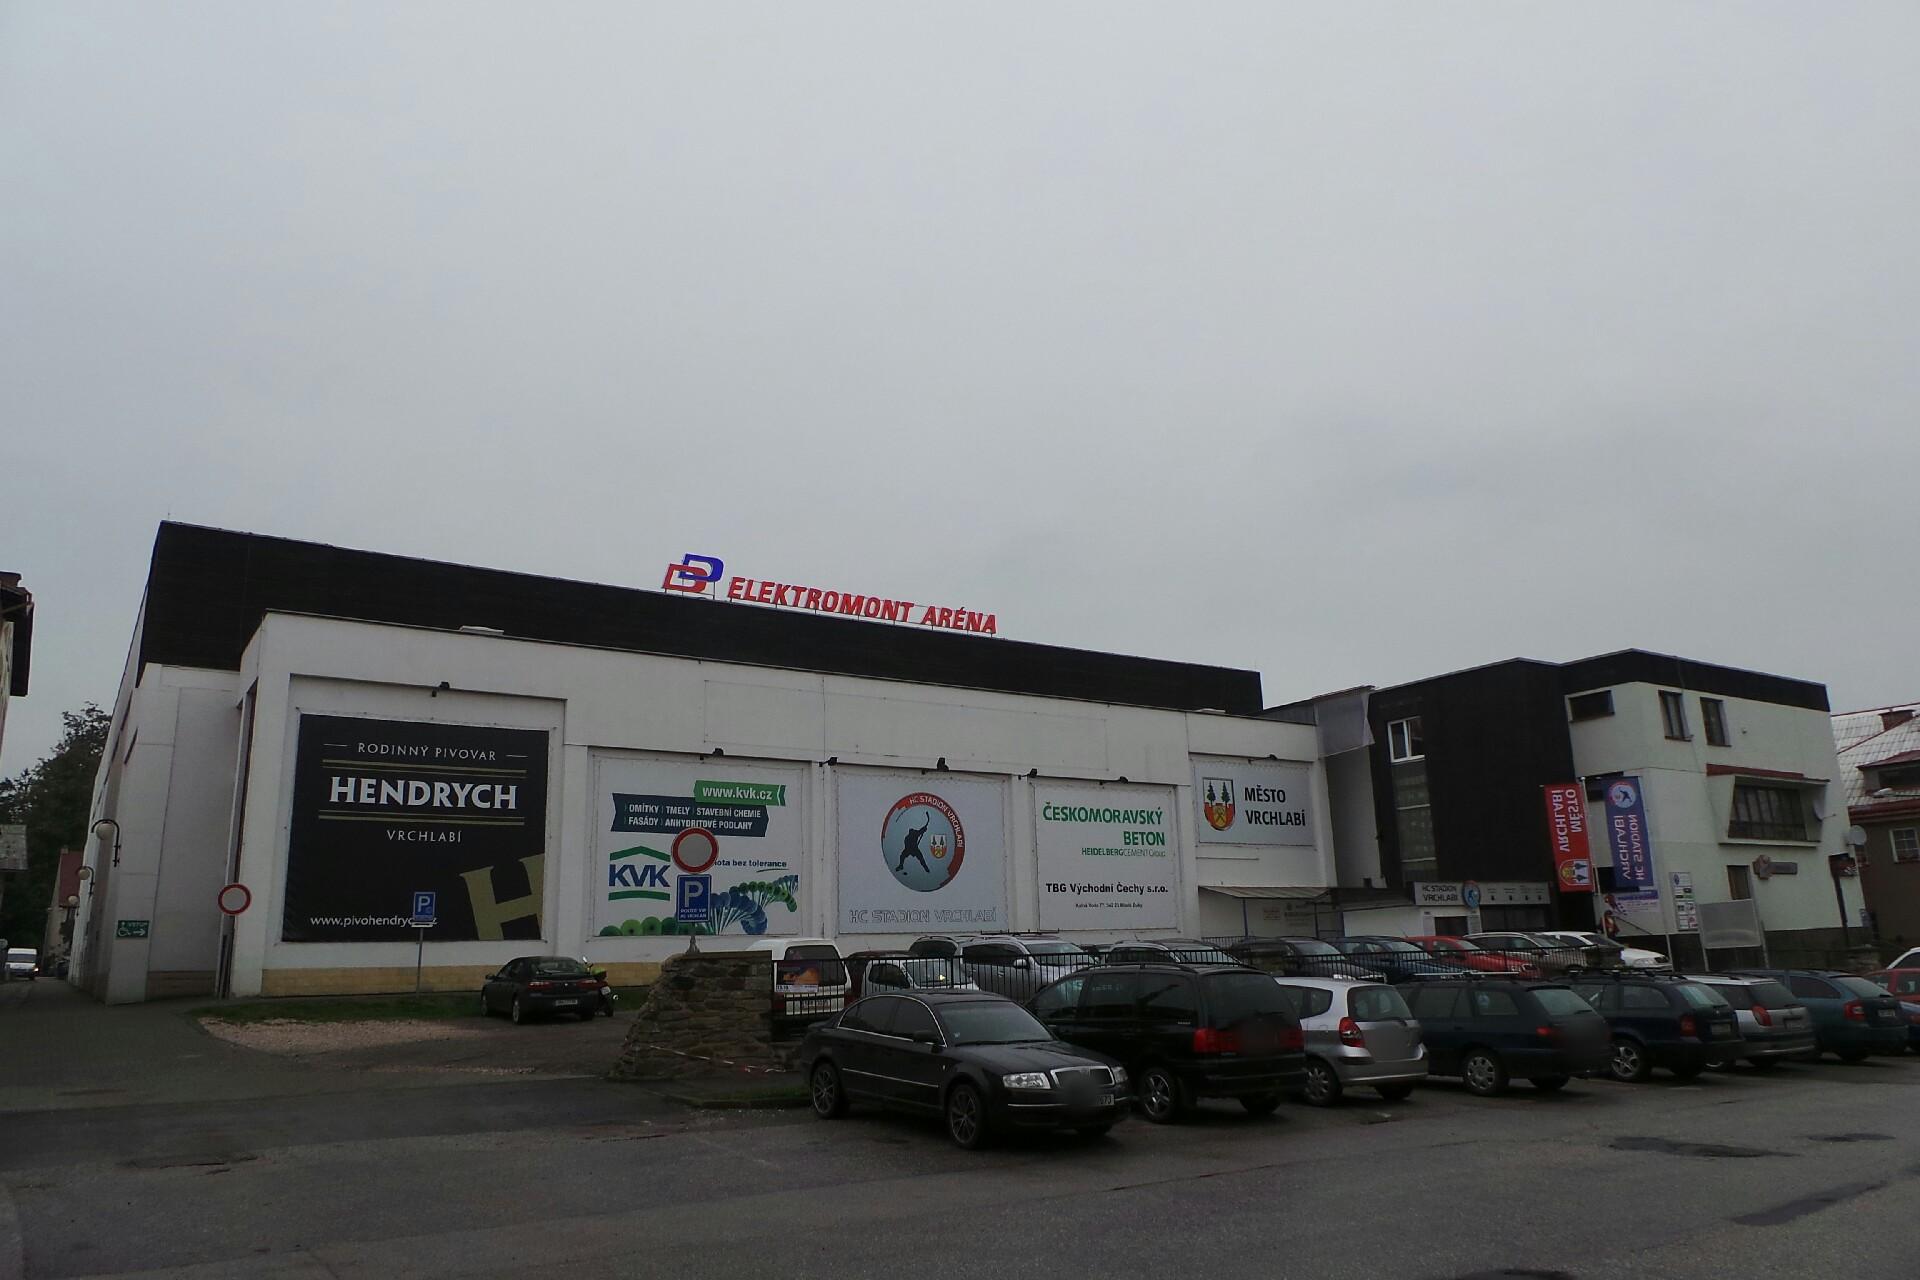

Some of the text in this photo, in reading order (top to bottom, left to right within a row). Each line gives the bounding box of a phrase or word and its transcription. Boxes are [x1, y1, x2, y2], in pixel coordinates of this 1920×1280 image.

[728, 576, 996, 634] ELEKTROMONT ARÉNA
[358, 742, 496, 761] RODINNÝ PIVOVAR
[329, 776, 518, 810] HENDRYCH
[702, 786, 773, 800] www.kvk.cz
[1244, 784, 1286, 803] MĚSTO
[629, 802, 761, 818] OMÍTKY TMELY STAVEBNÍ CHEMIE
[920, 796, 948, 813] STADION
[1043, 802, 1163, 825] ČESKOMORAVSKÝ
[1244, 809, 1306, 827] VRCHLABÍ
[628, 816, 659, 826] FASÁDY
[718, 820, 753, 830] PODLAHY
[387, 830, 462, 843] VRCHLABÍ
[1123, 831, 1165, 846] BETON
[733, 859, 748, 867] bez
[749, 859, 787, 868] tolerance
[608, 864, 671, 888] KVK
[684, 880, 704, 908] P
[1046, 882, 1169, 896] TBG Východní Čechy s.r.o.
[417, 896, 431, 912] P
[850, 906, 997, 924] HC STADION VRCHLABÍ
